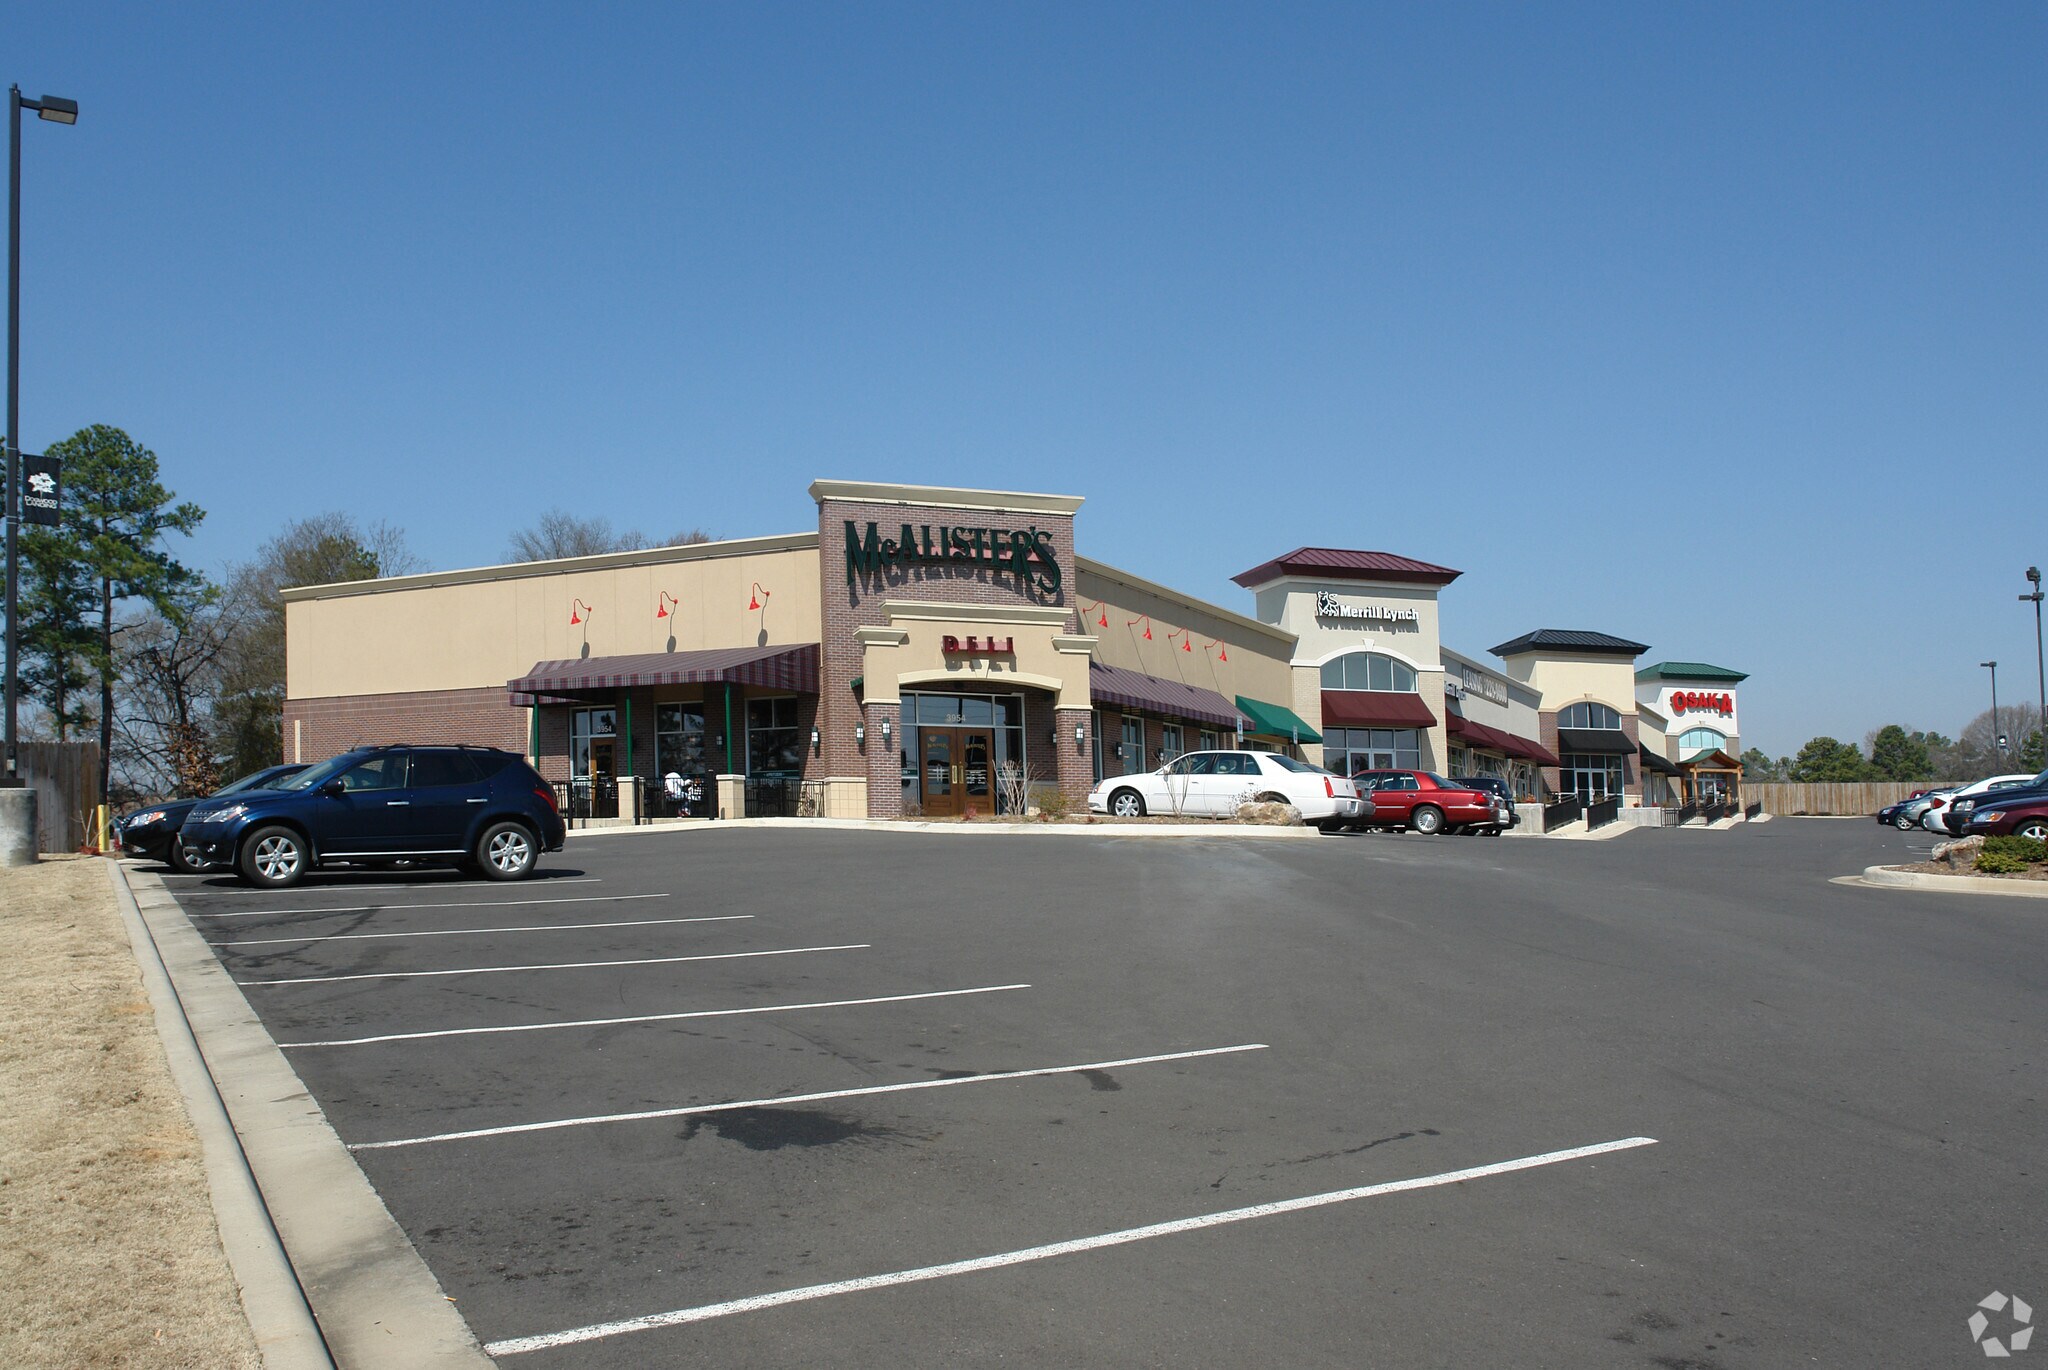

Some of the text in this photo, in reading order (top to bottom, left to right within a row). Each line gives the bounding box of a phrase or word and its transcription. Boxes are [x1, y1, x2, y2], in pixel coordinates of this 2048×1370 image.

[1340, 604, 1419, 622] Merrill Lynch
[942, 635, 1013, 654] DELI
[1672, 691, 1733, 713] OSAKA
[946, 713, 966, 722] 3954
